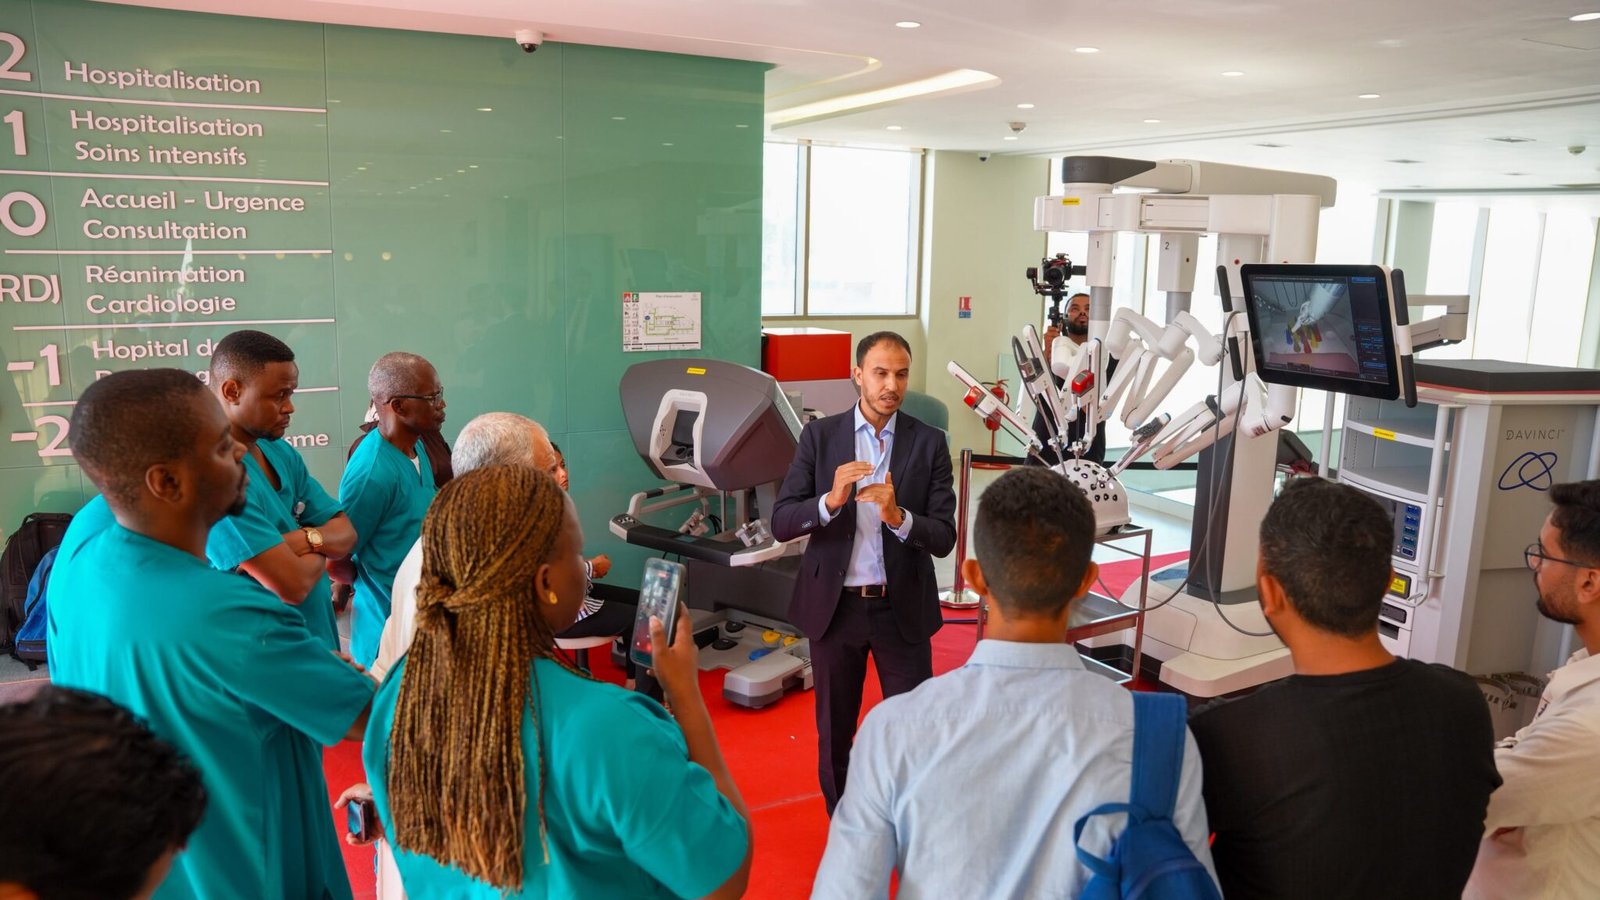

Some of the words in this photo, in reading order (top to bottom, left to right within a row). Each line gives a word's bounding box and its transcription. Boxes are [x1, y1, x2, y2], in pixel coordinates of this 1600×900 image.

[0, 32, 31, 82] 2
[64, 61, 260, 93] Hospitalisation
[3, 110, 28, 156] 1
[70, 109, 263, 137] Hospitalisation
[75, 141, 140, 162] Soins
[148, 145, 247, 166] intensifs
[80, 188, 176, 210] Accueil
[203, 190, 305, 213] Urgence
[83, 219, 247, 240] Consultation
[85, 265, 245, 284] Réanimation
[0, 274, 60, 304] RDJ
[86, 294, 236, 314] Cardiologie
[92, 338, 189, 361] Hopital
[6, 344, 61, 386] -1
[10, 415, 73, 457] -2
